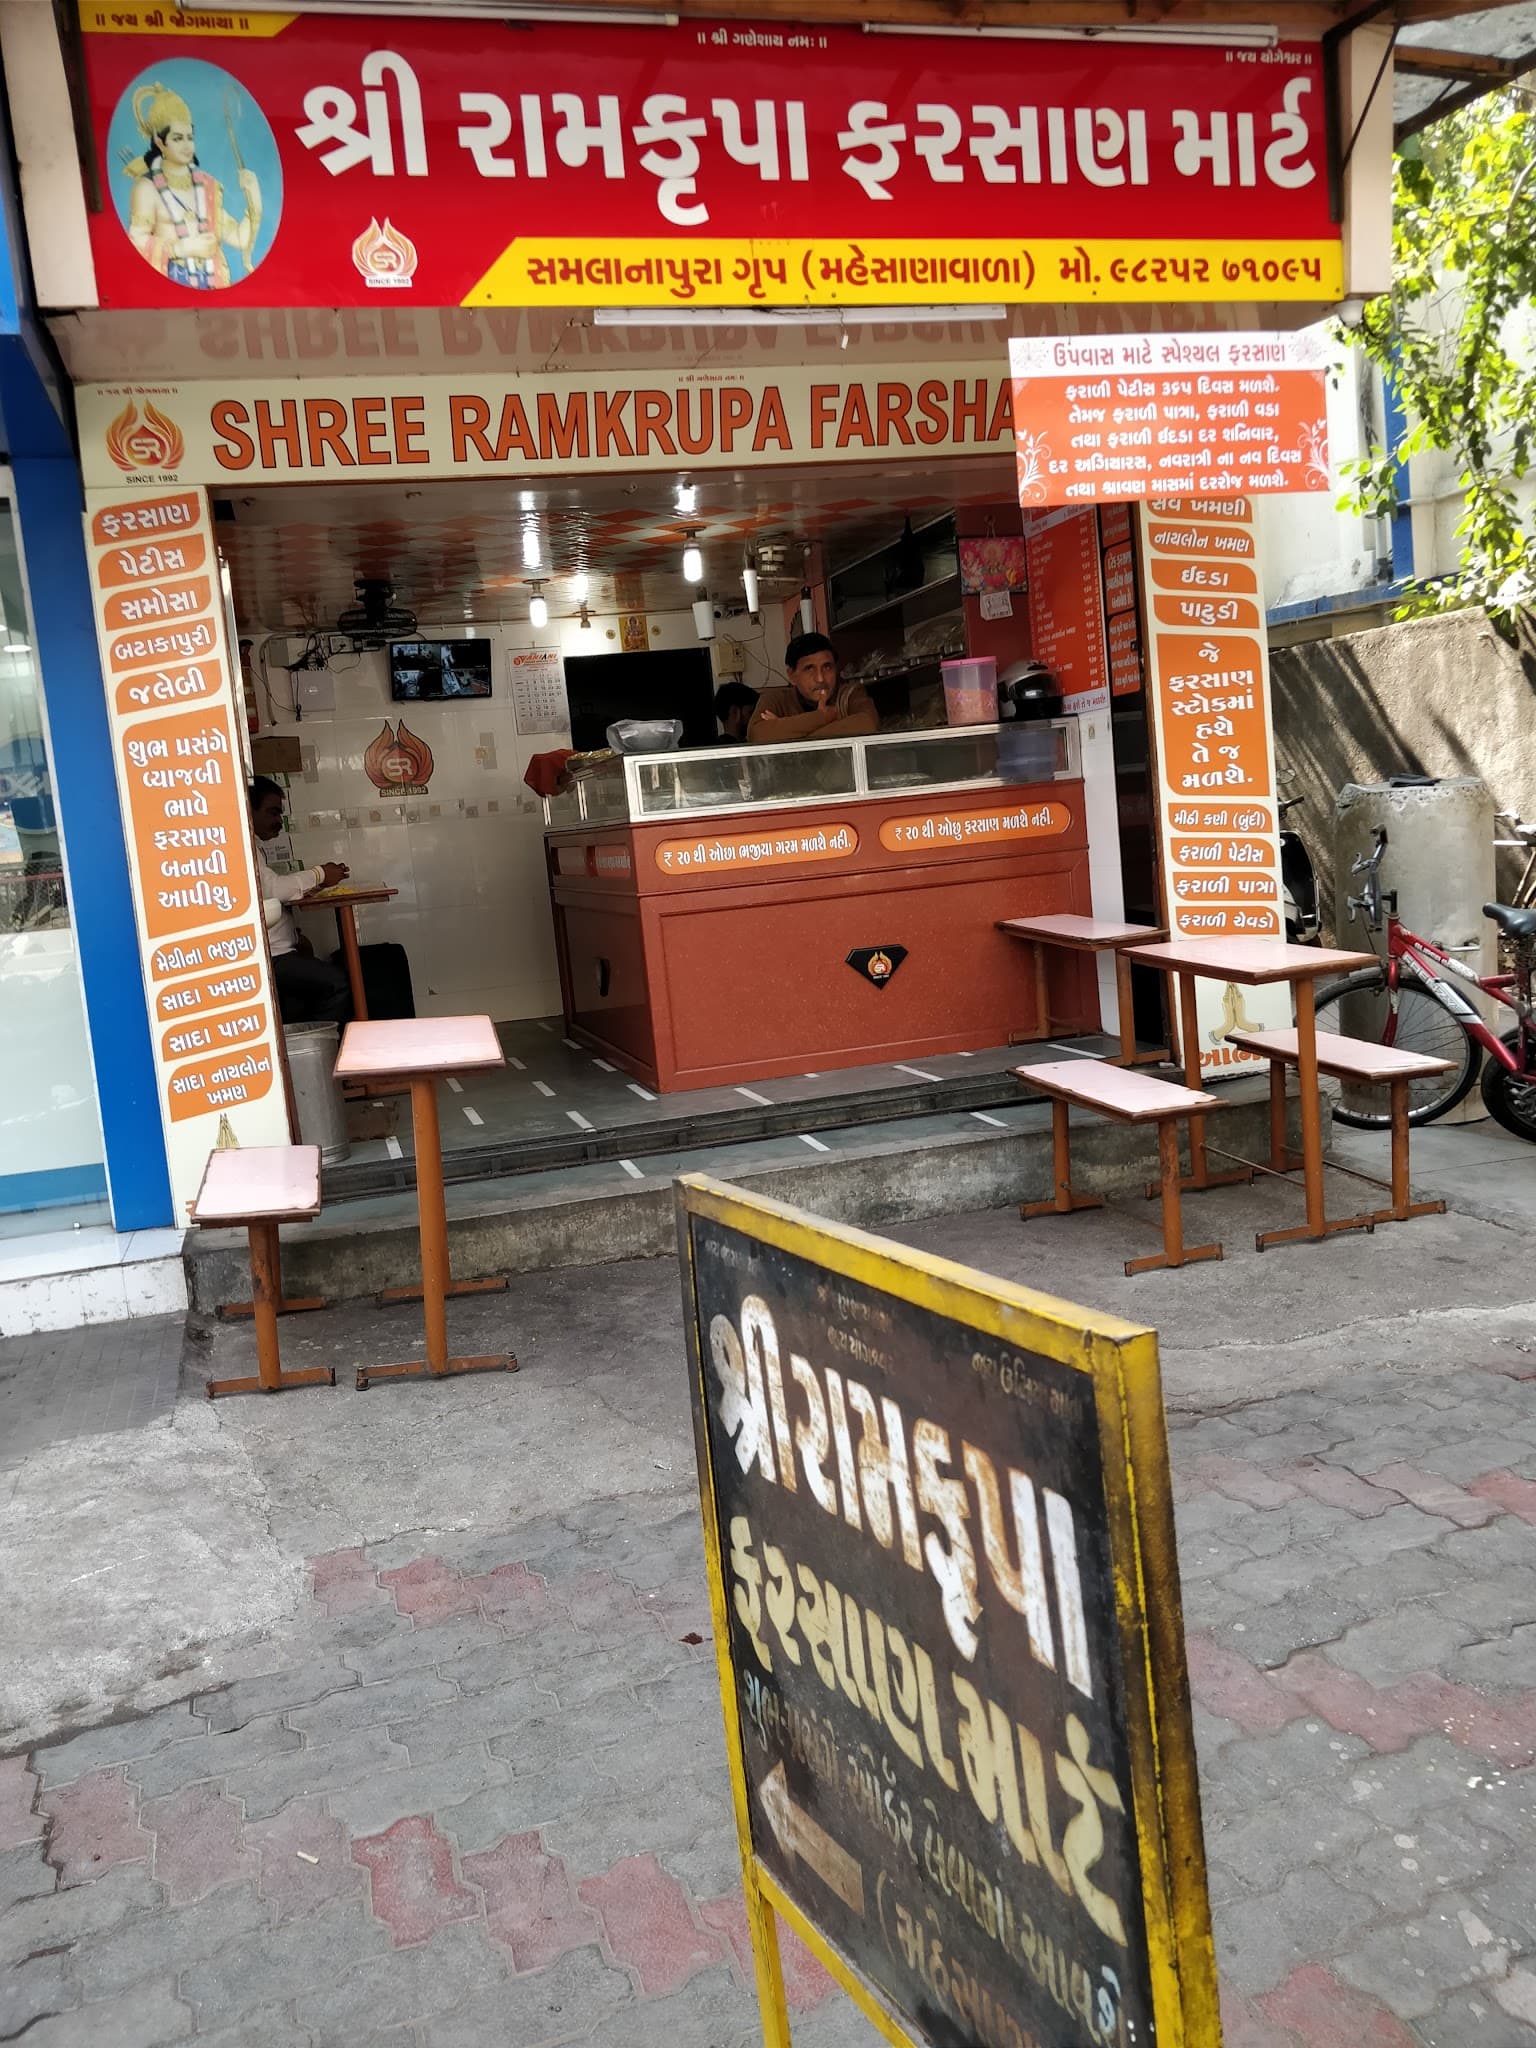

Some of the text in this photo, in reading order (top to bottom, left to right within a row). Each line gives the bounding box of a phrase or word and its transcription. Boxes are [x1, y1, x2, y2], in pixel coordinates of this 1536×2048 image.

[711, 28, 728, 45] શ્રી
[732, 29, 783, 48] ગણેશાય
[294, 49, 1317, 226] શ્રી રામકૃપા ફરસાણ માર્ટ
[527, 245, 1323, 299] સમલાનાપુરા ગૃપ (મહેસાણાવાળા) મો. ૯૮૨૫૨ ૭૧૦૯૫
[1122, 338, 1153, 366] માટે
[1161, 337, 1220, 364] સ્પેશ્યલ
[1228, 343, 1287, 366] ફરસાણ
[1064, 379, 1112, 402] ફરાળી
[1116, 378, 1156, 398] પેટીસ
[1197, 375, 1235, 395] દિવસ
[1238, 373, 1281, 394] મળશે.
[210, 378, 1017, 471] SHREE RAMKRUPA FARSHA
[1068, 404, 1106, 424] તેમજ
[1112, 402, 1158, 425] ફરાળી
[1206, 399, 1250, 421] ફરાળી
[1254, 402, 1280, 418] વડા
[1070, 432, 1102, 449] તથા
[1106, 427, 1153, 449] ફરાળી
[1198, 428, 1217, 443] દર
[1222, 422, 1280, 444] શનિવાર,
[1048, 459, 1069, 475] દર
[1158, 449, 1212, 469] નવરાત્રી
[1216, 451, 1235, 466] ના
[1239, 449, 1263, 465] નવ
[1266, 444, 1303, 464] દિવસ
[126, 474, 180, 485] SINCE 1992
[1065, 468, 1290, 498] તથા શ્રાવણ માસમાં દરરોજ મળશે.
[101, 502, 193, 539] ફરસાણ
[1190, 498, 1246, 517] ખમણી
[1153, 527, 1251, 554] નાયલોન ખમણ
[118, 545, 187, 578] પેટીસ
[1181, 565, 1229, 587] ઈદડા
[120, 587, 200, 622] સમોસા
[1179, 600, 1240, 627] પાટુડી
[114, 623, 212, 662] બટાકાપુરી
[1198, 641, 1221, 664] જે
[128, 665, 208, 706] જલેબી
[1168, 668, 1255, 695] ફરસાણ
[1171, 688, 1255, 717] સ્ટોકમાં
[1195, 715, 1235, 741] હશે
[127, 726, 230, 768] શુભ પ્રસંગે
[1191, 742, 1241, 764] તે જ
[141, 758, 223, 789] વ્યાજબી
[1181, 763, 1255, 790] મળશે.
[164, 789, 210, 819] ભાવે
[1174, 809, 1200, 826] મીઠી
[1203, 810, 1228, 827] કણી
[153, 825, 228, 851] ફરસાણ
[921, 818, 935, 839] થી
[964, 817, 1000, 836] ફરસાણ
[1001, 808, 1029, 830] મળશે
[692, 843, 707, 864] થી
[709, 840, 737, 862] ઓછા
[738, 842, 773, 862] ભજીયા
[775, 839, 799, 855] ગરમ
[800, 830, 827, 853] મળશે
[1178, 842, 1265, 864] ફરાળી પેટીસ
[160, 848, 229, 879] બનાવી
[157, 879, 238, 913] આપીશુ.
[1176, 875, 1276, 897] ફરાળી પાત્રા
[1178, 911, 1275, 930] ફરાળી ચેવડો
[155, 934, 255, 974] મેથીના ભજીયા
[161, 974, 257, 1012] સાદા ખમણ
[168, 1014, 261, 1054] સાદા પાત્રા
[172, 1054, 272, 1095] સાદા નાયલોન
[206, 1084, 248, 1106] ખમણ
[729, 1515, 1128, 1948] ફરસાણ માર્ટ
